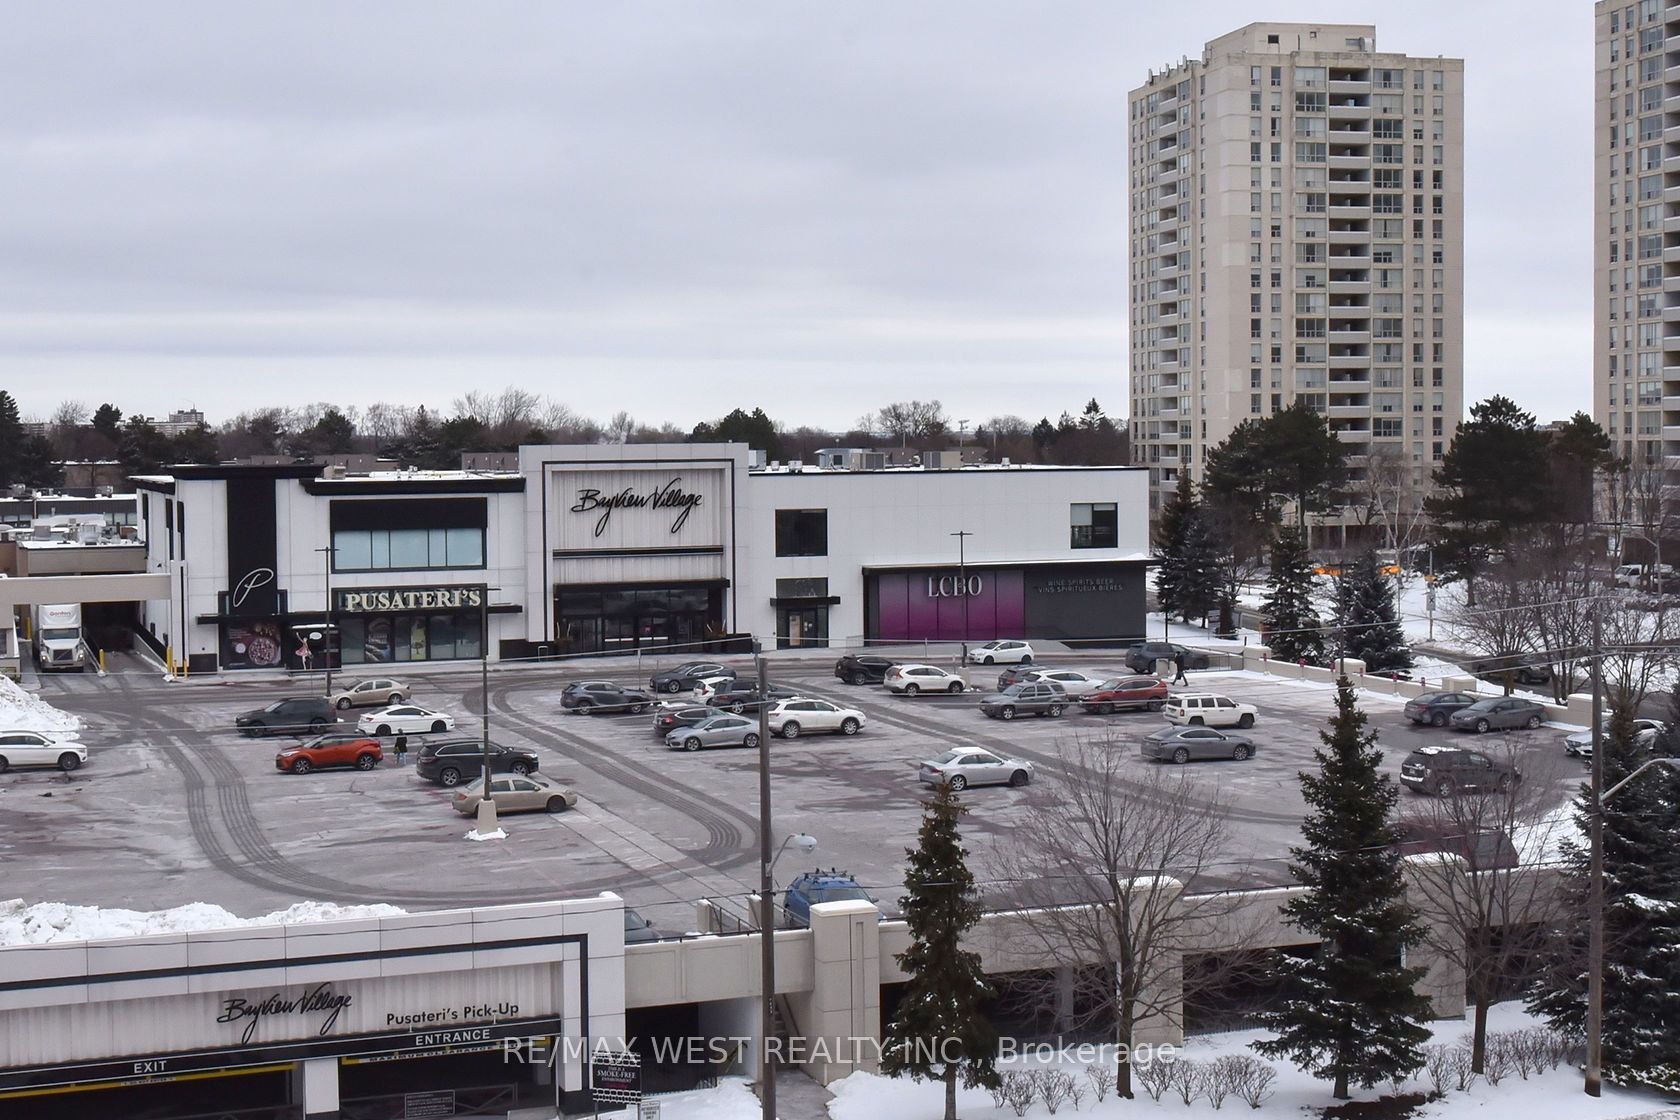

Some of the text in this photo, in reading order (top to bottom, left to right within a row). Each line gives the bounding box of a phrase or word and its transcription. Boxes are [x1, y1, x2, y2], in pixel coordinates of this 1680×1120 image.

[647, 477, 702, 533] Village
[928, 575, 982, 597] LCBO
[345, 590, 481, 611] PUSATERI'S
[297, 981, 352, 1036] Village
[386, 1002, 519, 1026] Pusateri's Pick-Up
[415, 1028, 491, 1046] ENTRANCE
[133, 1060, 167, 1074] EXIT
[597, 1070, 636, 1079] SMOKE-FREE
